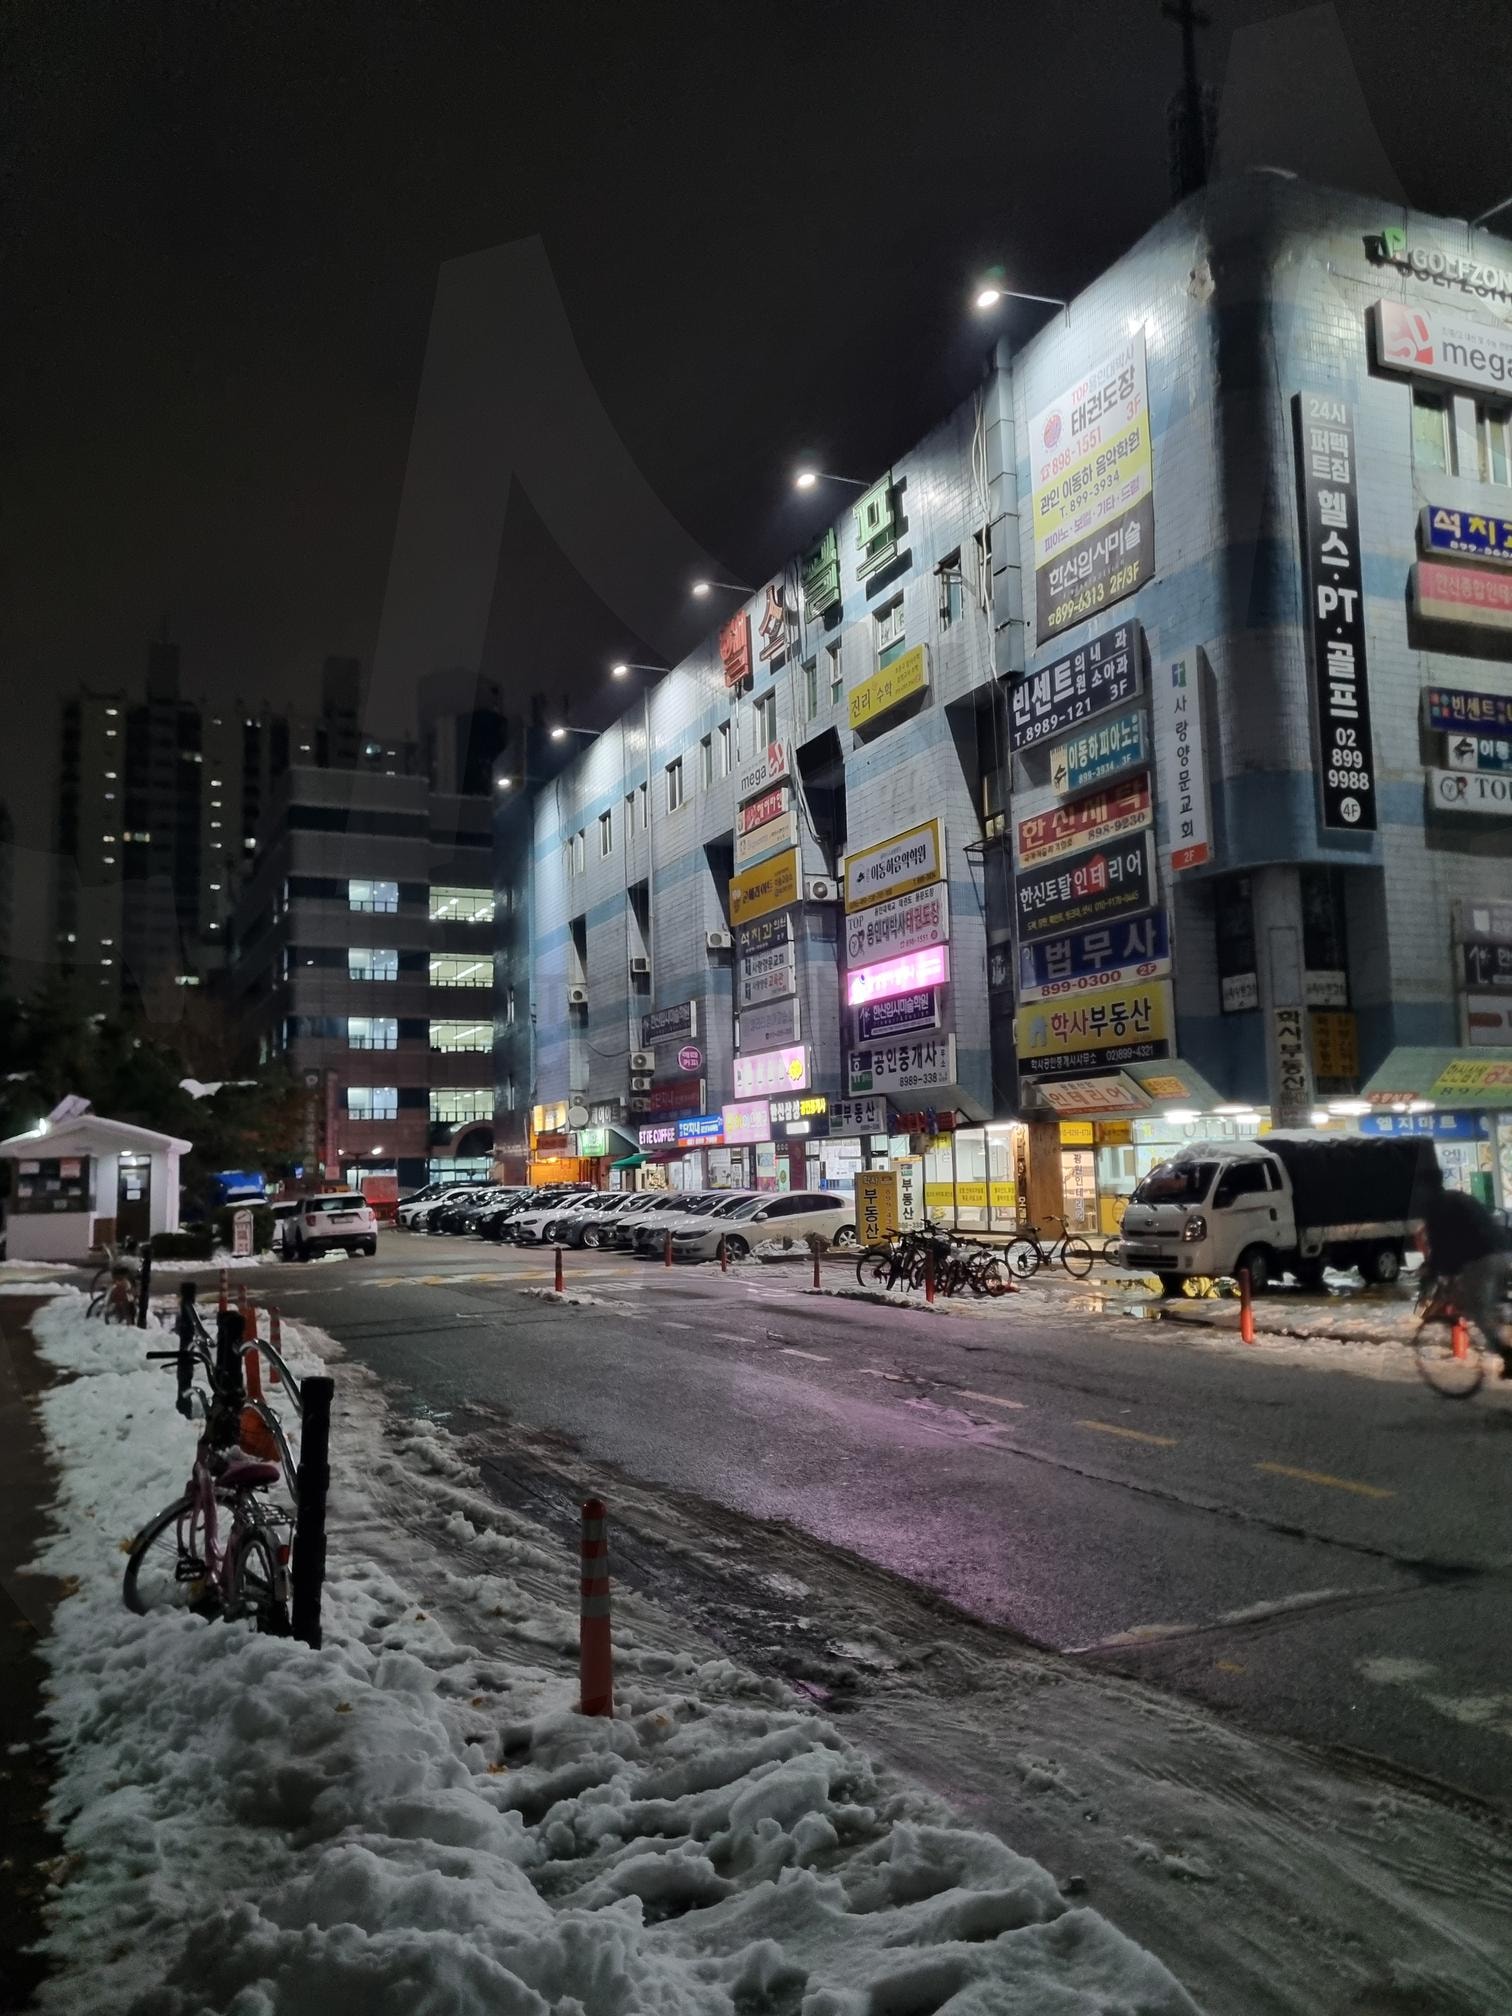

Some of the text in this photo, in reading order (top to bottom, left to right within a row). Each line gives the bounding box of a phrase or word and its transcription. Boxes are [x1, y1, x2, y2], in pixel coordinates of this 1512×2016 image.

[1070, 364, 1136, 437] 태권도장
[1125, 392, 1143, 423] 3F
[1309, 398, 1347, 425] 24시
[1040, 427, 1141, 516] 관인 이동하 음악학원
[1069, 469, 1121, 513] 899-3934
[1044, 527, 1069, 553] 피아노
[1048, 520, 1141, 597] 한신입시미술
[1055, 583, 1105, 625] 899-6313
[1109, 560, 1141, 594] 2F/3F
[1317, 489, 1359, 719] 헬스 PT 골프
[1091, 654, 1129, 689] 소아과
[1012, 660, 1075, 727] 빈센트
[1109, 679, 1128, 702] 3F
[1334, 727, 1358, 748] 02
[1331, 748, 1364, 770] 899
[740, 765, 767, 791] mega
[1327, 769, 1370, 791] 9988
[1342, 803, 1359, 818] 4F
[1182, 850, 1196, 862] 2F
[1019, 849, 1143, 913] 한신토탈인테리어
[1044, 917, 1157, 980] 법무사
[1040, 970, 1122, 998] 899-0300
[1049, 997, 1152, 1045] 학사부동산
[873, 1040, 938, 1076] 공인중개사
[843, 1100, 876, 1124] 부동산
[863, 1187, 880, 1240] 부동산
[901, 1178, 915, 1221] 부동산
